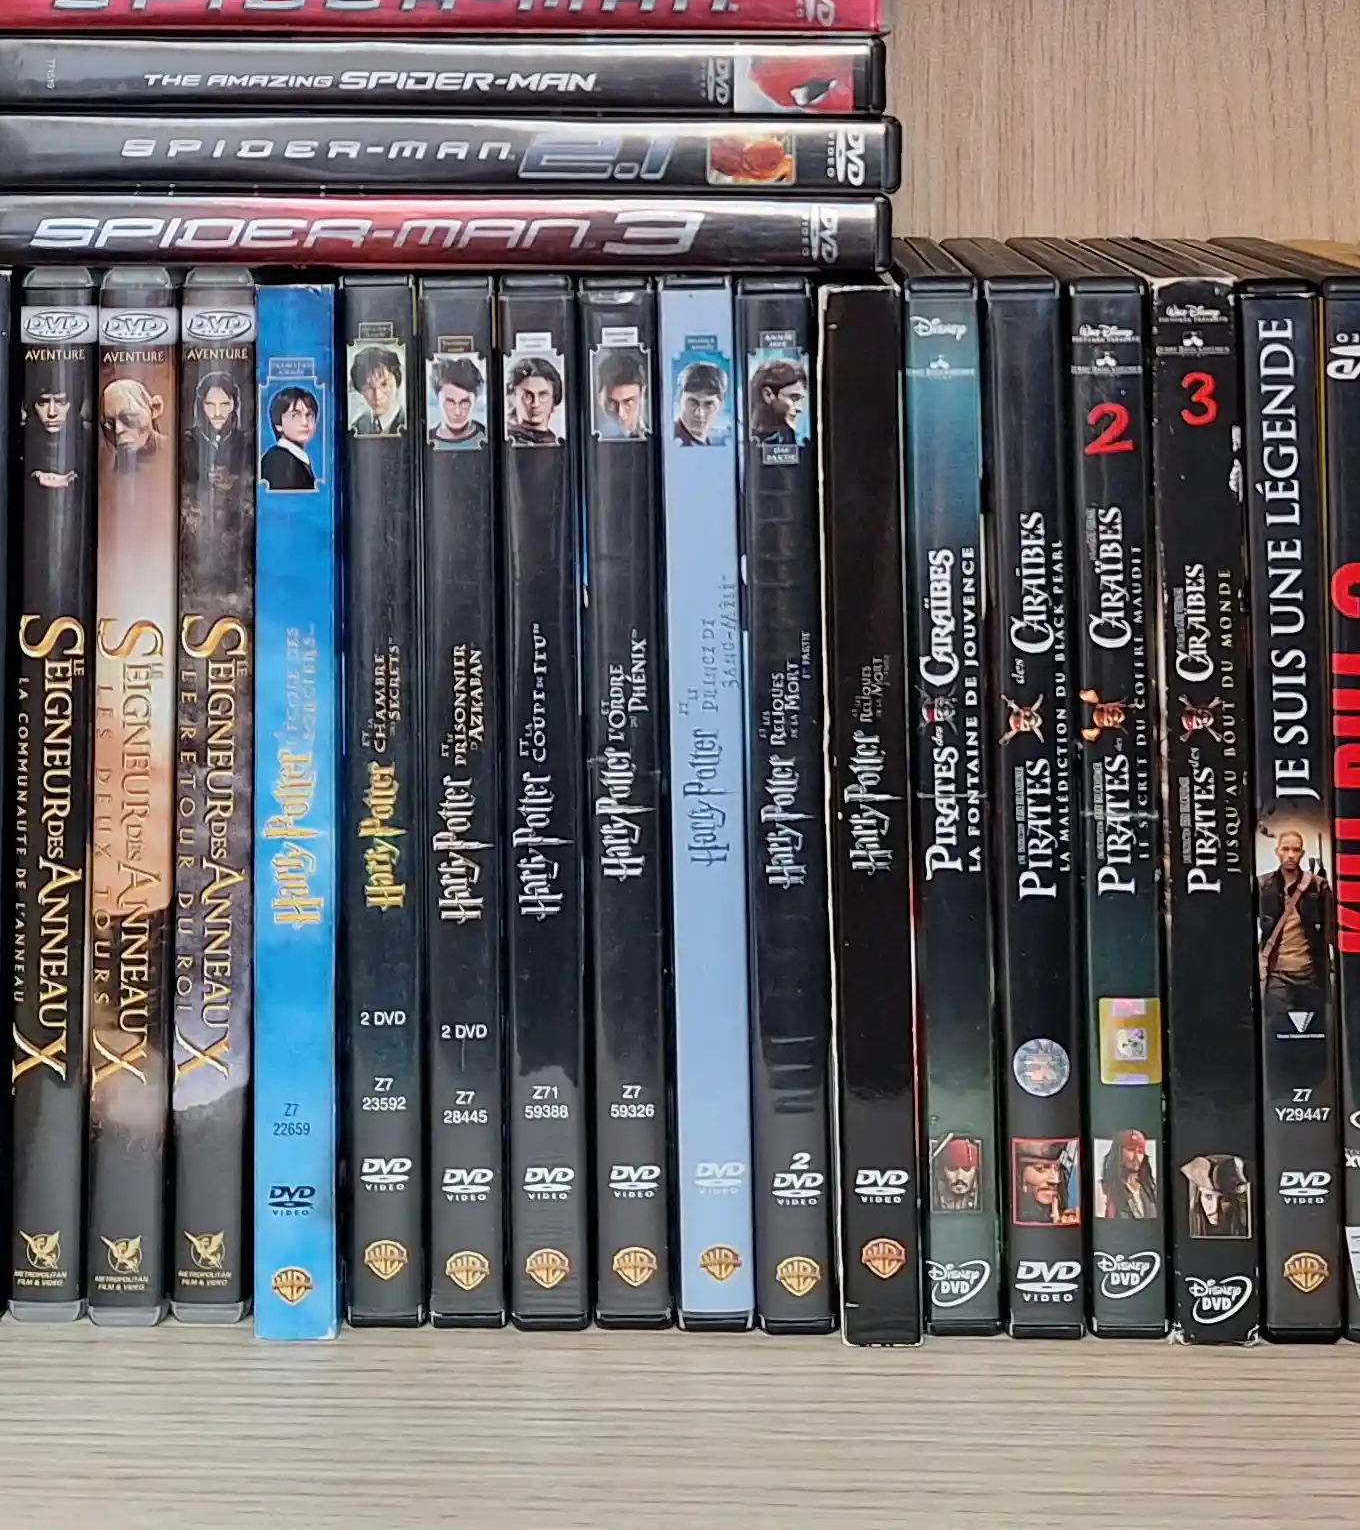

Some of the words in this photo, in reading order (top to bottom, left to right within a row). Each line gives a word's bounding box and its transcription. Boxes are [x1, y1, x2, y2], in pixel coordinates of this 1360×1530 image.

[144, 73, 201, 88] THE
[207, 73, 333, 89] AMAZING
[338, 70, 597, 92] SPIDER-MAN
[843, 128, 866, 187] DVD
[29, 217, 590, 251] SPIDER-MAN
[603, 210, 705, 256] 3
[24, 348, 86, 362] AVENTURE
[103, 350, 165, 363] AVENTURE
[186, 347, 249, 361] AVENTURE
[1084, 402, 1134, 455] 2
[1180, 372, 1218, 427] 3
[1254, 318, 1303, 525] LÉGENDE
[1051, 539, 1064, 595] PEARL
[1088, 506, 1133, 649] CARAÏBES
[1129, 546, 1145, 625] MAUDIT
[1264, 538, 1307, 637] UNE
[920, 548, 961, 686] CARAÏBES
[961, 546, 980, 667] JOUVENCE
[1052, 603, 1067, 662] BLACK
[1175, 563, 1214, 682] CARAÏBES
[1217, 570, 1233, 648] MONDE
[18, 677, 30, 700] LA
[179, 670, 196, 705] LE
[373, 653, 387, 754] CHAMBRE
[388, 645, 401, 722] SECRETS
[453, 642, 468, 767] PRISONNIER
[607, 664, 627, 742] L'ORDRE
[625, 637, 649, 712] PHÉNIX
[769, 672, 787, 746] RELIQUES
[784, 660, 801, 711] MORT
[964, 676, 979, 705] DE
[1054, 672, 1067, 697] DU
[1219, 660, 1234, 688] DU
[1269, 648, 1310, 745] SUIS
[18, 614, 85, 821] SEIGNEUR
[96, 684, 114, 740] LES
[97, 617, 166, 824] SEIGNEUR
[180, 613, 249, 823] SEIGNEUR
[1134, 719, 1148, 745] DU
[1221, 701, 1237, 757] BOUT
[178, 723, 199, 868] RETOUR
[261, 749, 328, 841] Potter
[357, 760, 410, 838] Potter
[595, 745, 656, 817] Potter
[681, 727, 739, 801] Potter
[759, 753, 815, 825] Potter
[843, 730, 905, 807] Potter
[964, 716, 981, 837] FONTAINE
[1052, 708, 1070, 841] MALÉDICTION
[1272, 758, 1321, 800] JE
[94, 767, 113, 859] DEUX
[432, 773, 495, 852] Potter
[511, 769, 575, 850] Potter
[687, 799, 730, 868] Harry
[848, 804, 894, 876] Harry
[925, 746, 964, 881] PIRATES
[1018, 758, 1059, 901] PIRATES
[1097, 753, 1136, 896] PIRATES
[1186, 766, 1223, 895] PIRATES
[1223, 770, 1242, 874] JUSQU'AU
[15, 867, 28, 889] DE
[363, 837, 408, 911] Harry
[600, 814, 645, 882] Harry
[764, 822, 808, 890] Harry
[967, 845, 982, 873] LA
[1058, 851, 1071, 872] LA
[177, 891, 195, 935] DU
[270, 841, 325, 929] Harry
[436, 850, 485, 926] Harry
[516, 848, 564, 921] Harry
[11, 857, 83, 1082] ANNEAUX
[13, 902, 26, 1002] L'ANNEAU
[90, 860, 163, 1086] ANNEAUX
[92, 886, 111, 1005] TOURS
[175, 857, 247, 1083] ANNEAUX
[176, 954, 194, 1012] ROI
[360, 1012, 370, 1026] 2
[373, 1011, 406, 1026] DVD
[441, 1024, 452, 1039] 2
[454, 1024, 488, 1039] DVD
[362, 1096, 407, 1111] 23592
[374, 1077, 393, 1091] Z7
[443, 1110, 488, 1124] 28445
[524, 1104, 569, 1119] 59388
[532, 1085, 558, 1099] Z71
[610, 1104, 655, 1118] 59326
[1275, 1107, 1330, 1122] Y29447
[1293, 1088, 1313, 1102] Z7
[272, 1122, 311, 1136] 22659
